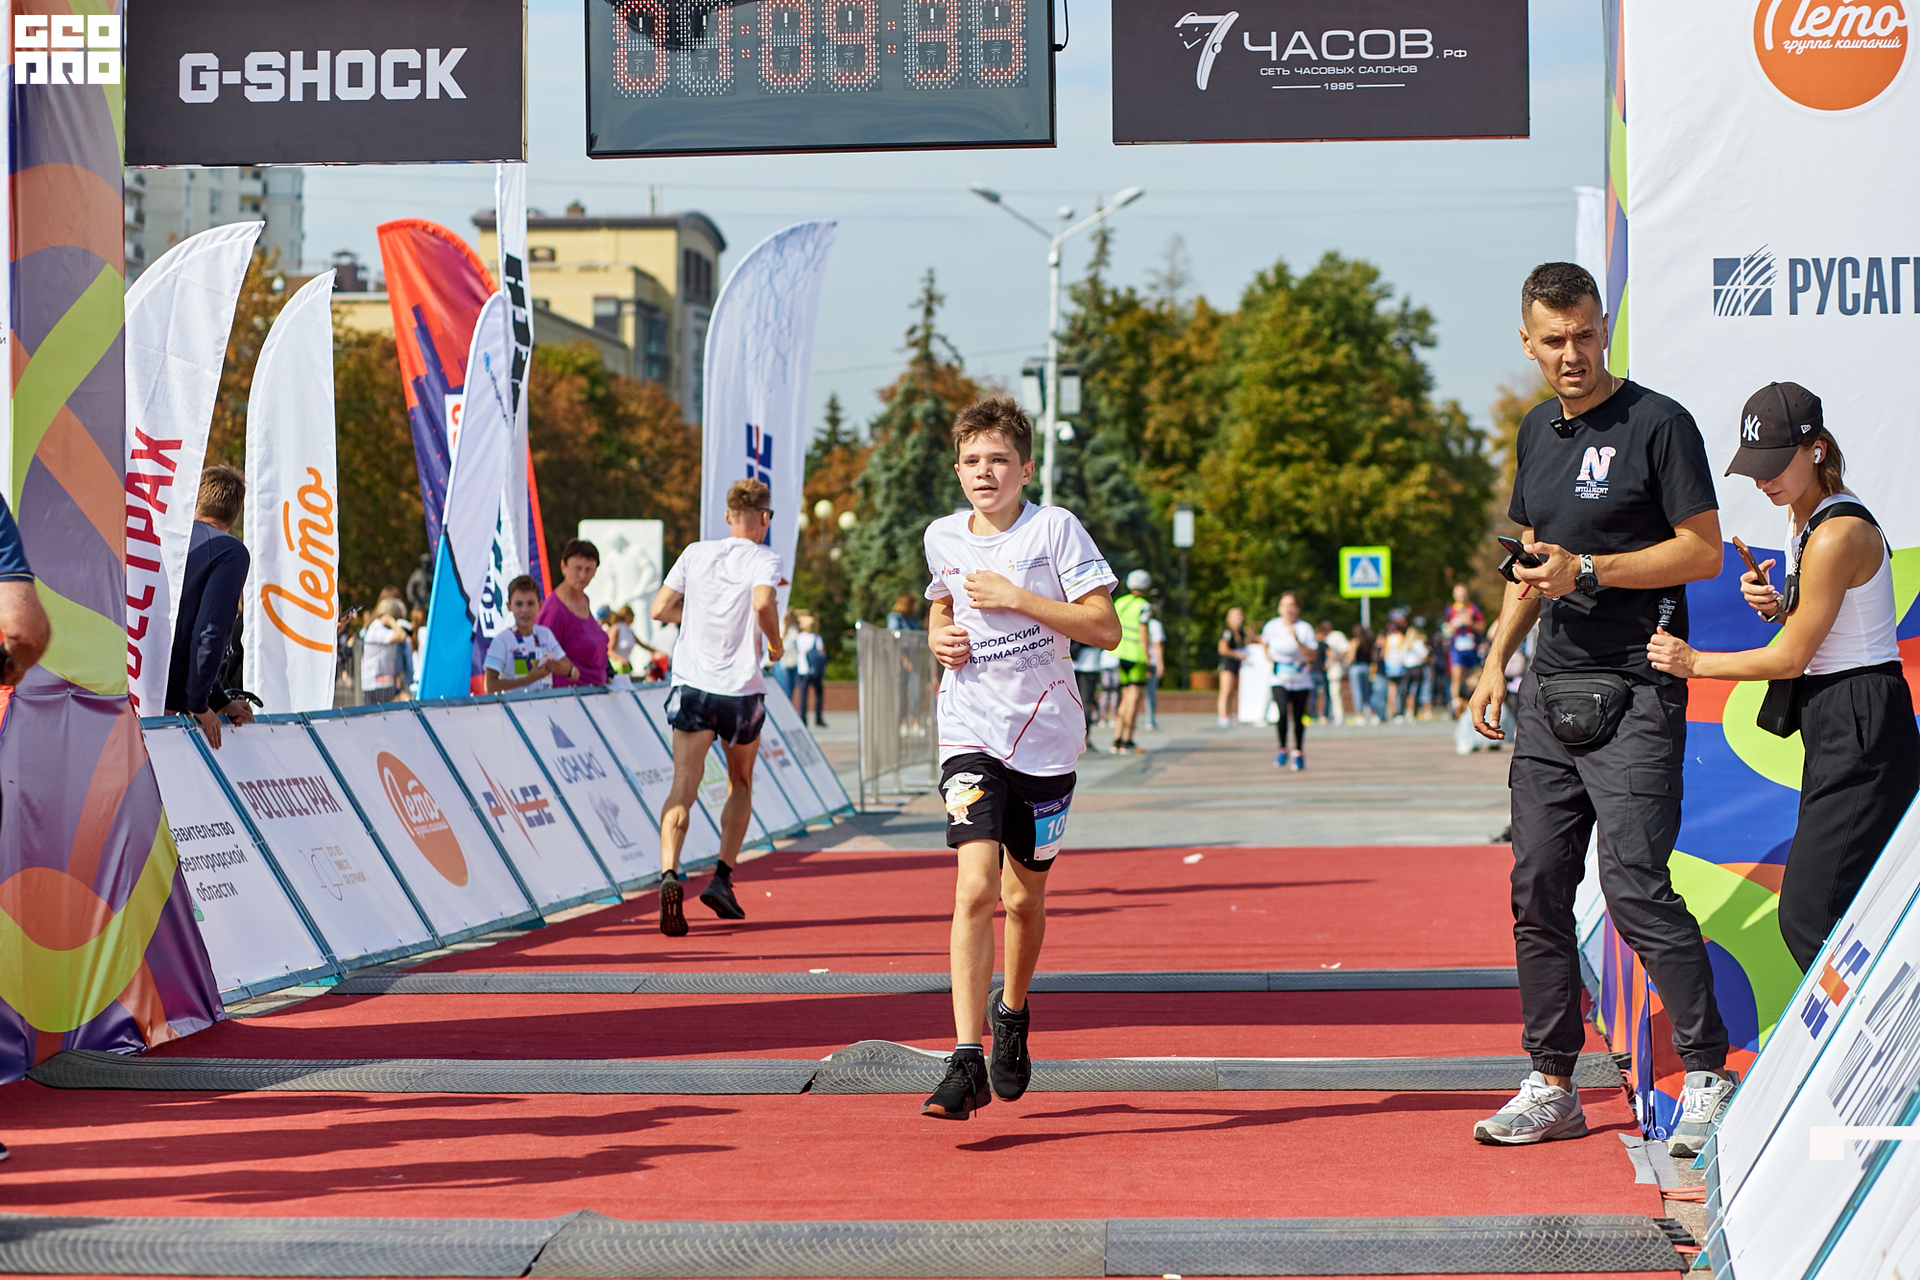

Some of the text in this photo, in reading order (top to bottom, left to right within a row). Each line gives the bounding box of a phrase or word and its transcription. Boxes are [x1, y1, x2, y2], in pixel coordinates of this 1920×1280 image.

[1782, 36, 1902, 55] группа компаний
[178, 47, 469, 104] G-SHOCK
[1259, 65, 1418, 77] СЕТЬ ЧАСОВЫХ САЛОНОВ
[1323, 82, 1354, 91] 1995
[1788, 255, 1920, 317] РУСАГ
[1015, 648, 1056, 673] 2021
[236, 775, 343, 821] РОСГОССТРАХ
[169, 820, 236, 848] равительство
[1047, 814, 1068, 841] 10
[196, 881, 239, 902] области
